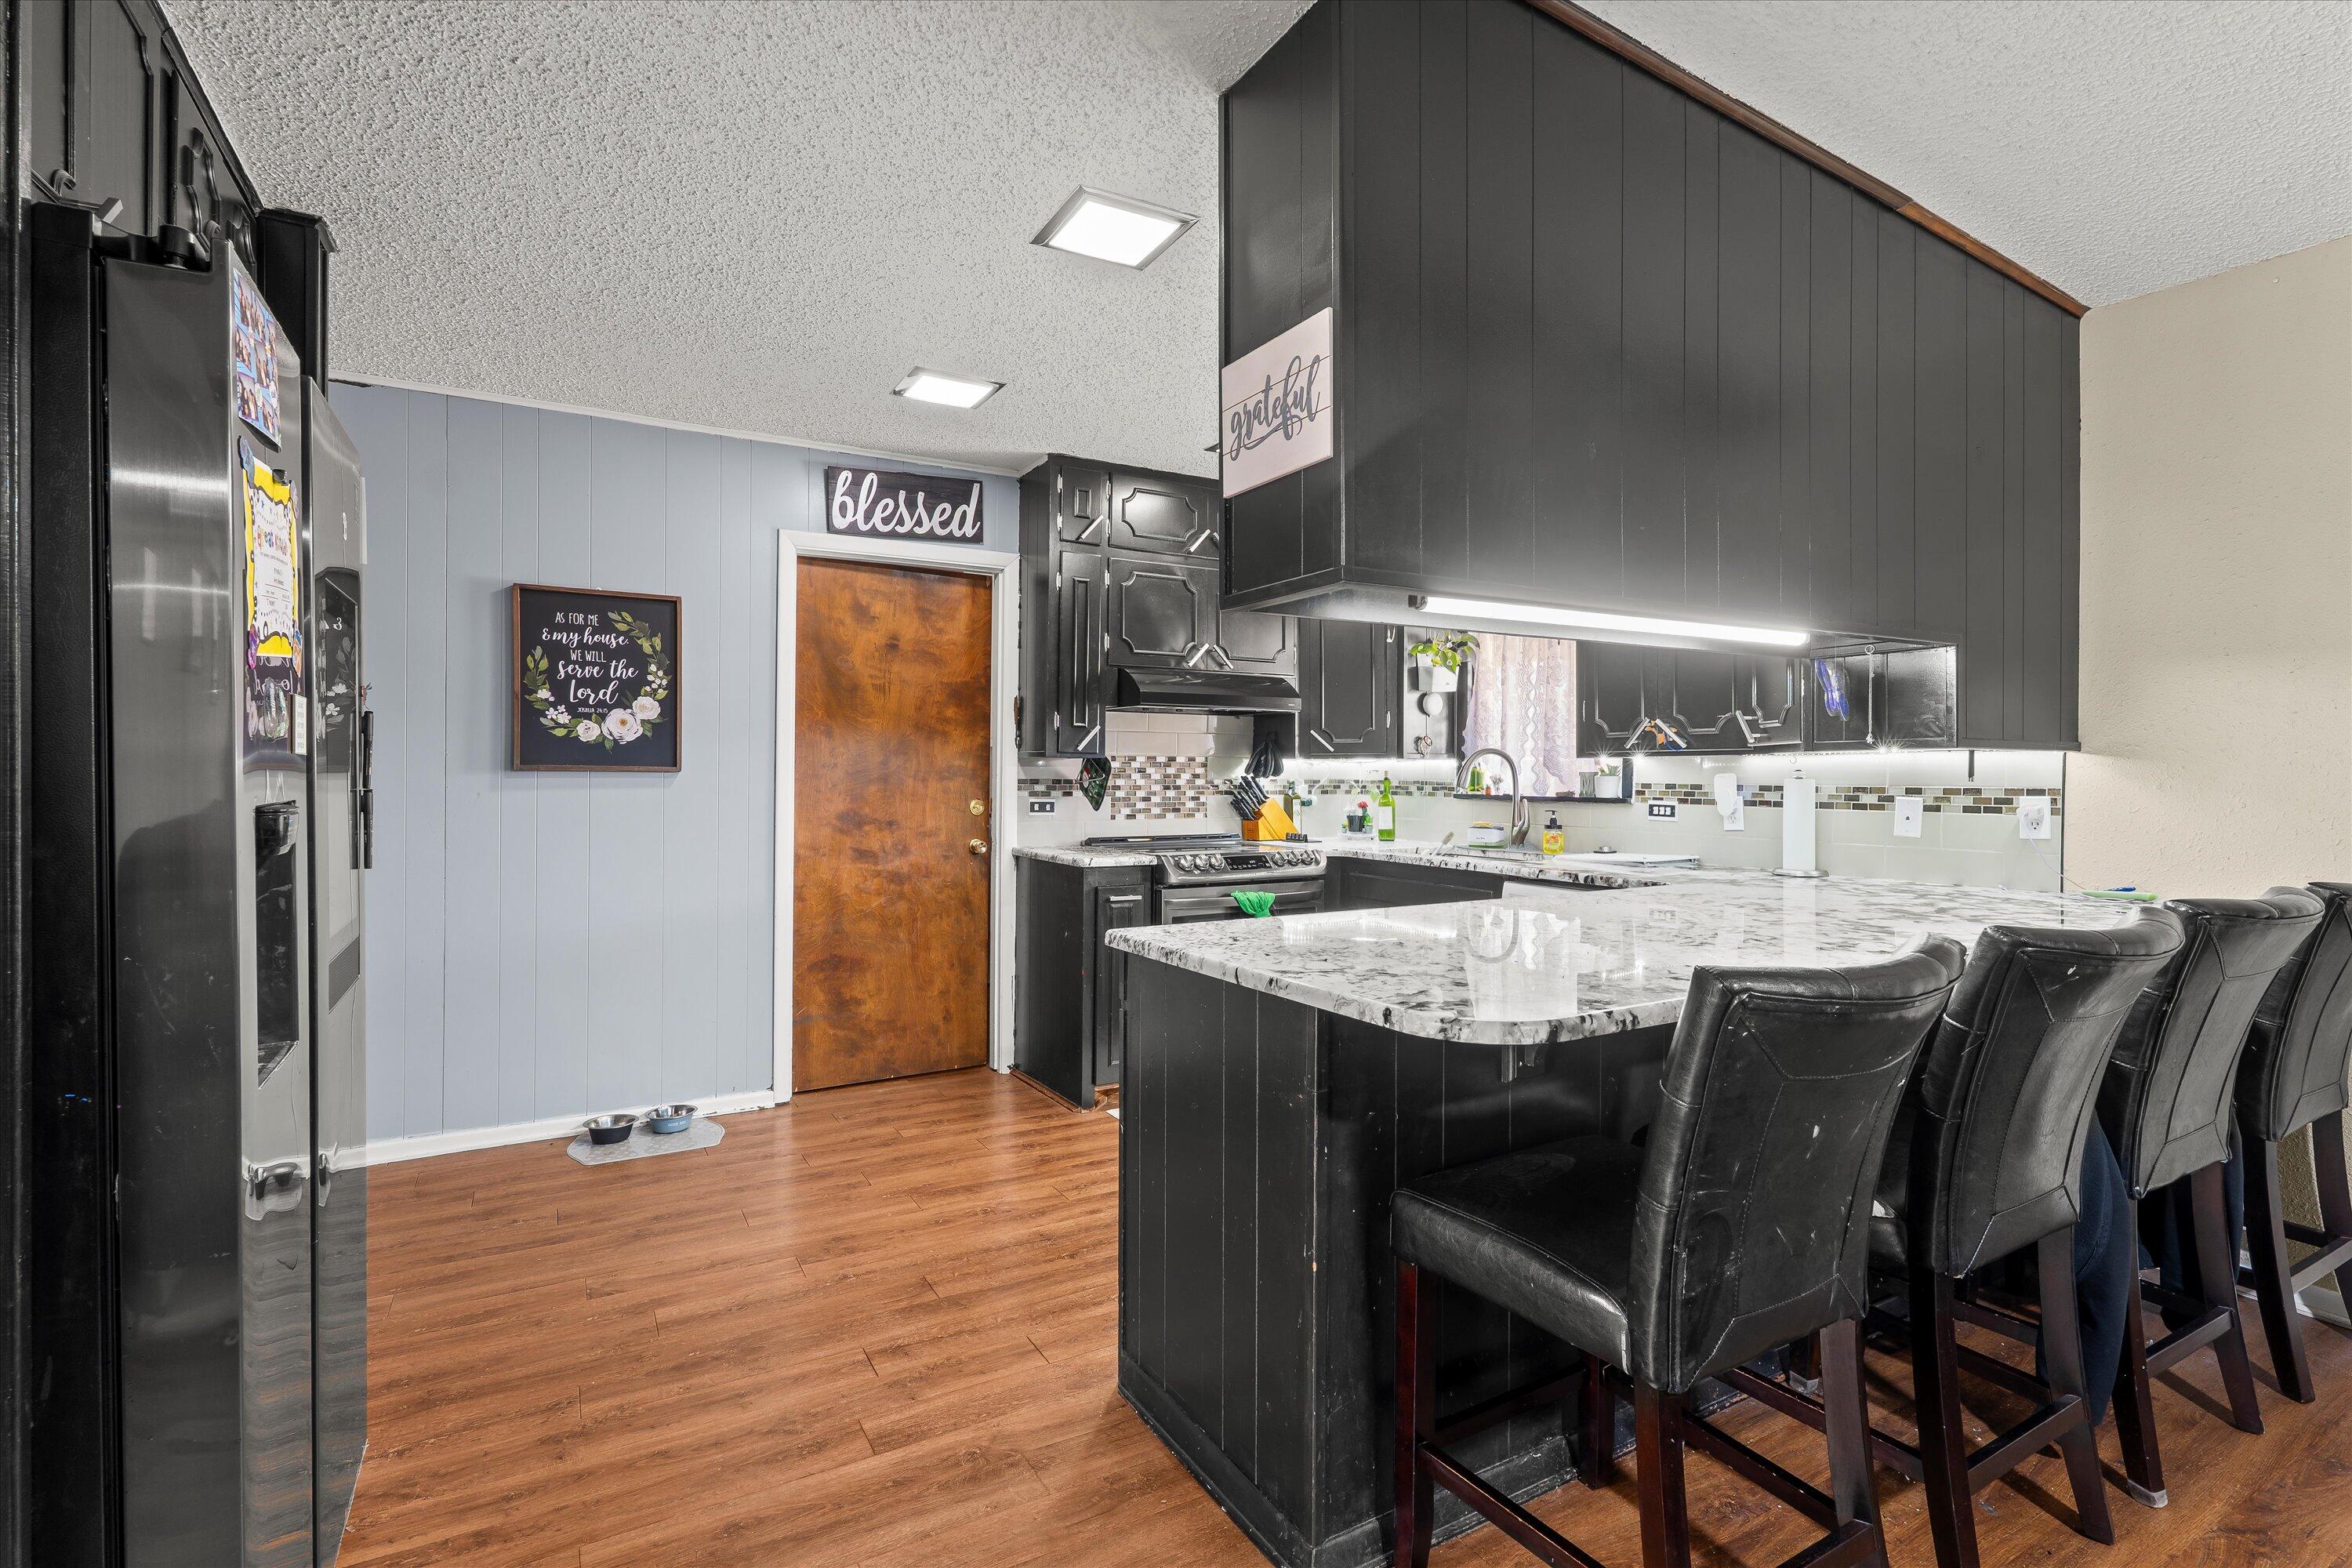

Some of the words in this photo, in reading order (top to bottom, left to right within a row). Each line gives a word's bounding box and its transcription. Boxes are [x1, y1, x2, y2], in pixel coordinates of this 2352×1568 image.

[1230, 354, 1320, 461] grateful
[832, 470, 980, 537] blessed
[555, 612, 565, 623] AS
[568, 613, 584, 625] FOR
[588, 614, 599, 626] ME
[552, 633, 582, 648] my
[570, 649, 582, 661] WE
[585, 650, 606, 662] WILL
[610, 659, 638, 679] the
[570, 679, 619, 705] Lord
